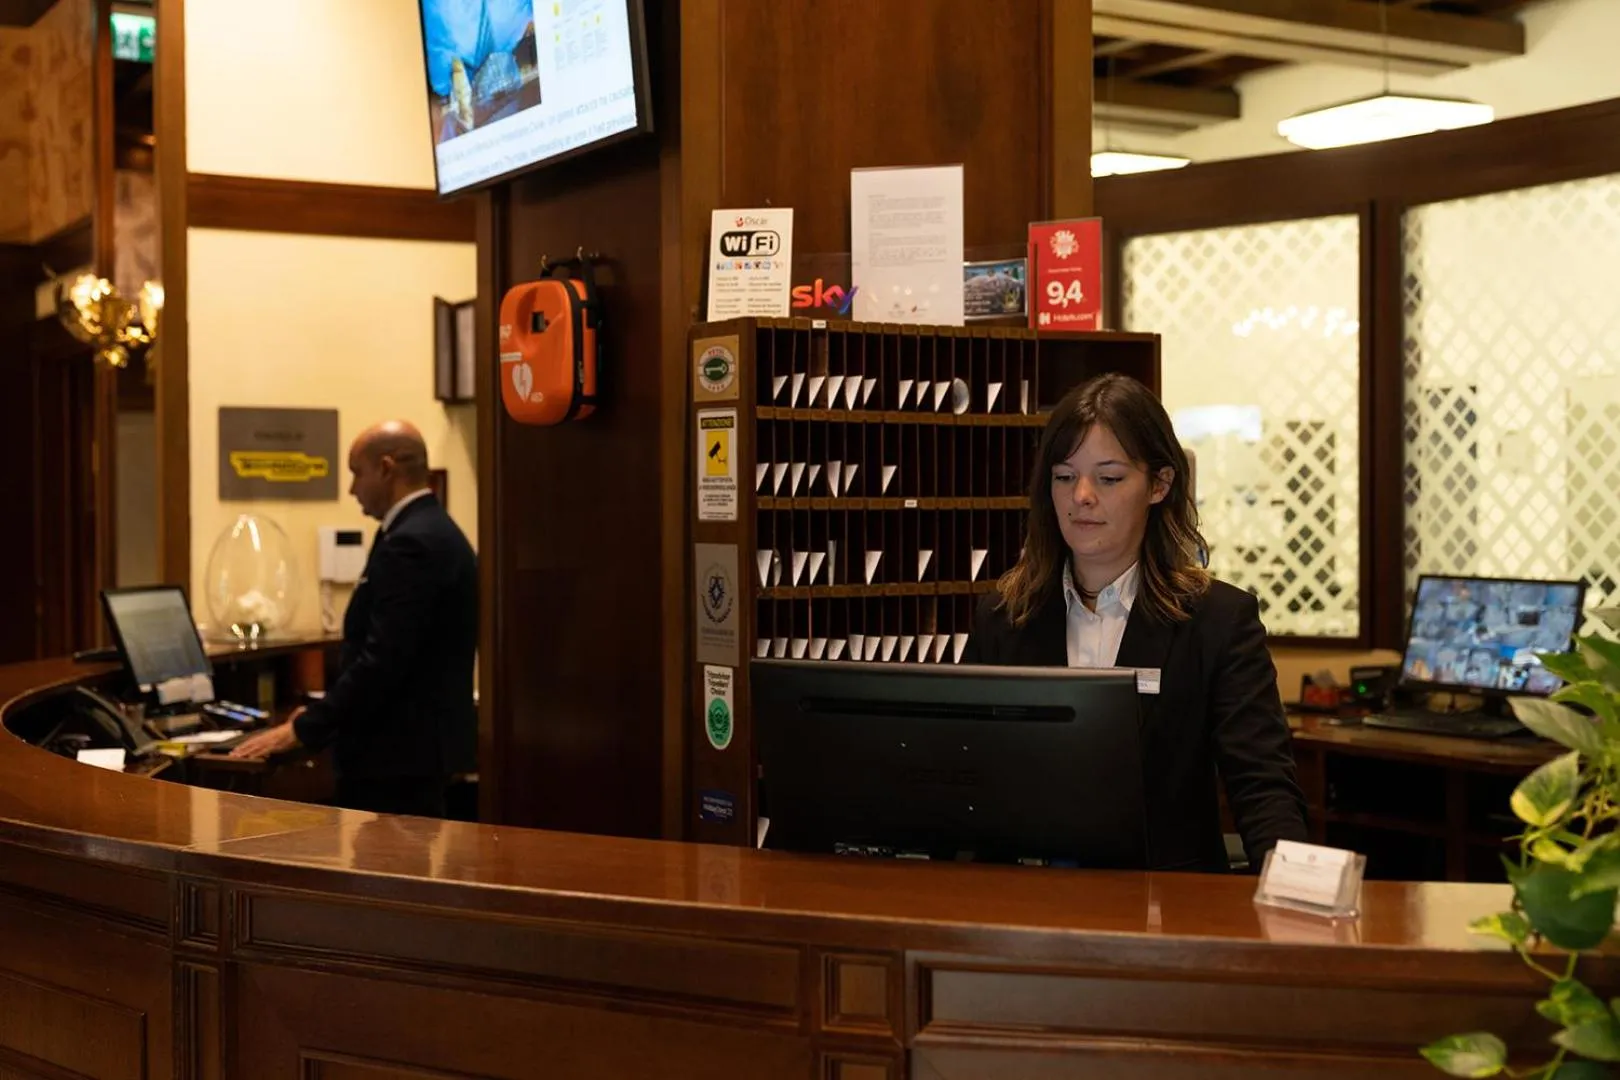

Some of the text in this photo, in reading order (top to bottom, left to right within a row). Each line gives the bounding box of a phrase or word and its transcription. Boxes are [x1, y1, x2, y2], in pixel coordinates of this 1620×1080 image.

[744, 215, 768, 225] Oscar
[791, 278, 859, 315] sky
[1046, 279, 1084, 308] 9,4
